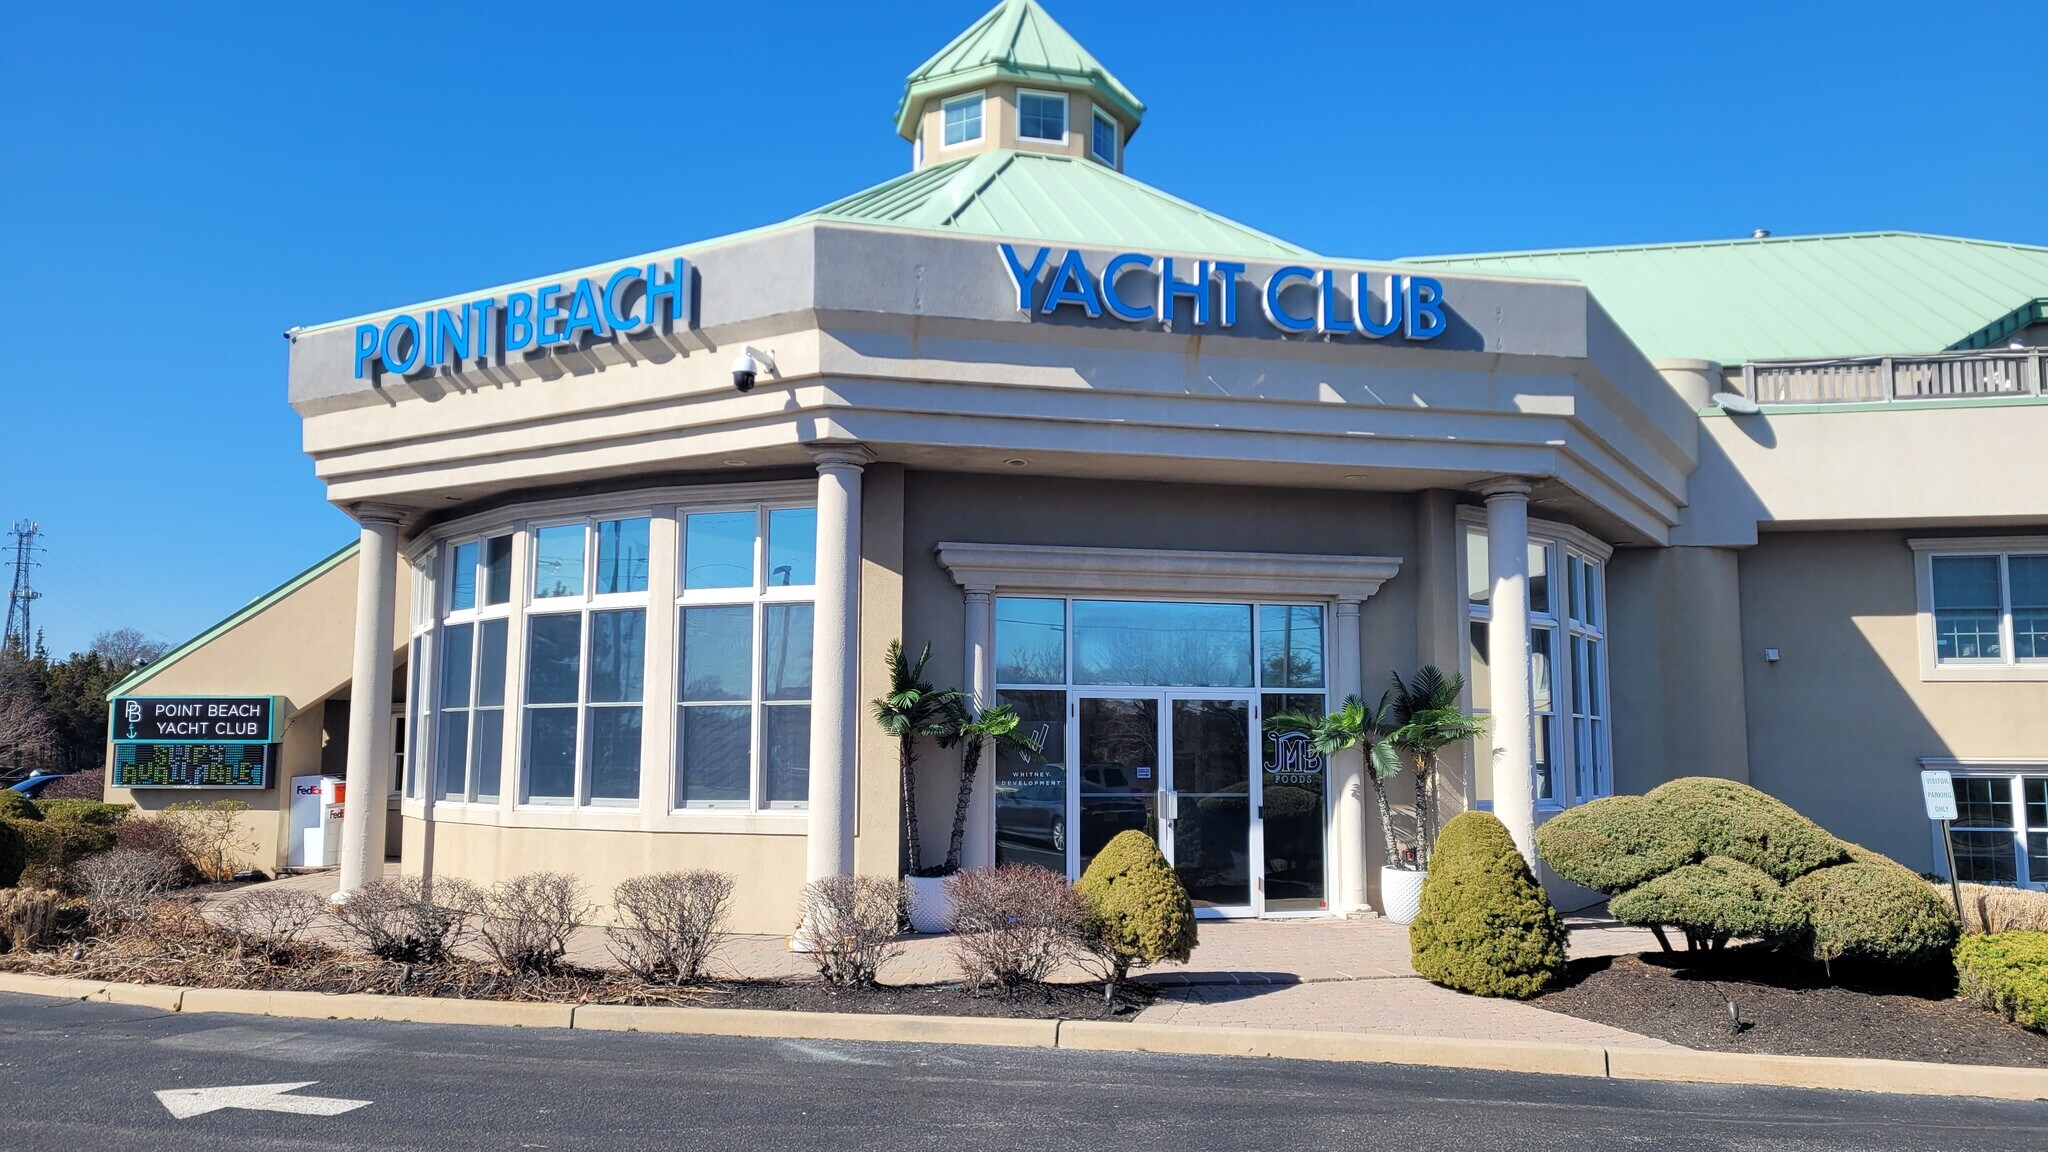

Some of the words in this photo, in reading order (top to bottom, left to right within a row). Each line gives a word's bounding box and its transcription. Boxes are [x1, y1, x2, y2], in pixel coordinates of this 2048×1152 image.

[997, 243, 1246, 327] YACHT
[1263, 265, 1447, 340] CLUB
[355, 297, 496, 380] POINT
[506, 257, 686, 352] BEACH
[155, 704, 203, 717] POINT
[207, 704, 260, 717] BEACH
[156, 722, 210, 735] YACHT
[214, 722, 258, 735] CLUB
[1275, 775, 1313, 784] FOODS
[1925, 777, 1949, 785] VISITOR
[296, 785, 323, 795] FedEx
[1927, 791, 1952, 799] PARKING
[330, 808, 345, 819] FedE
[1934, 805, 1949, 813] ONLY
